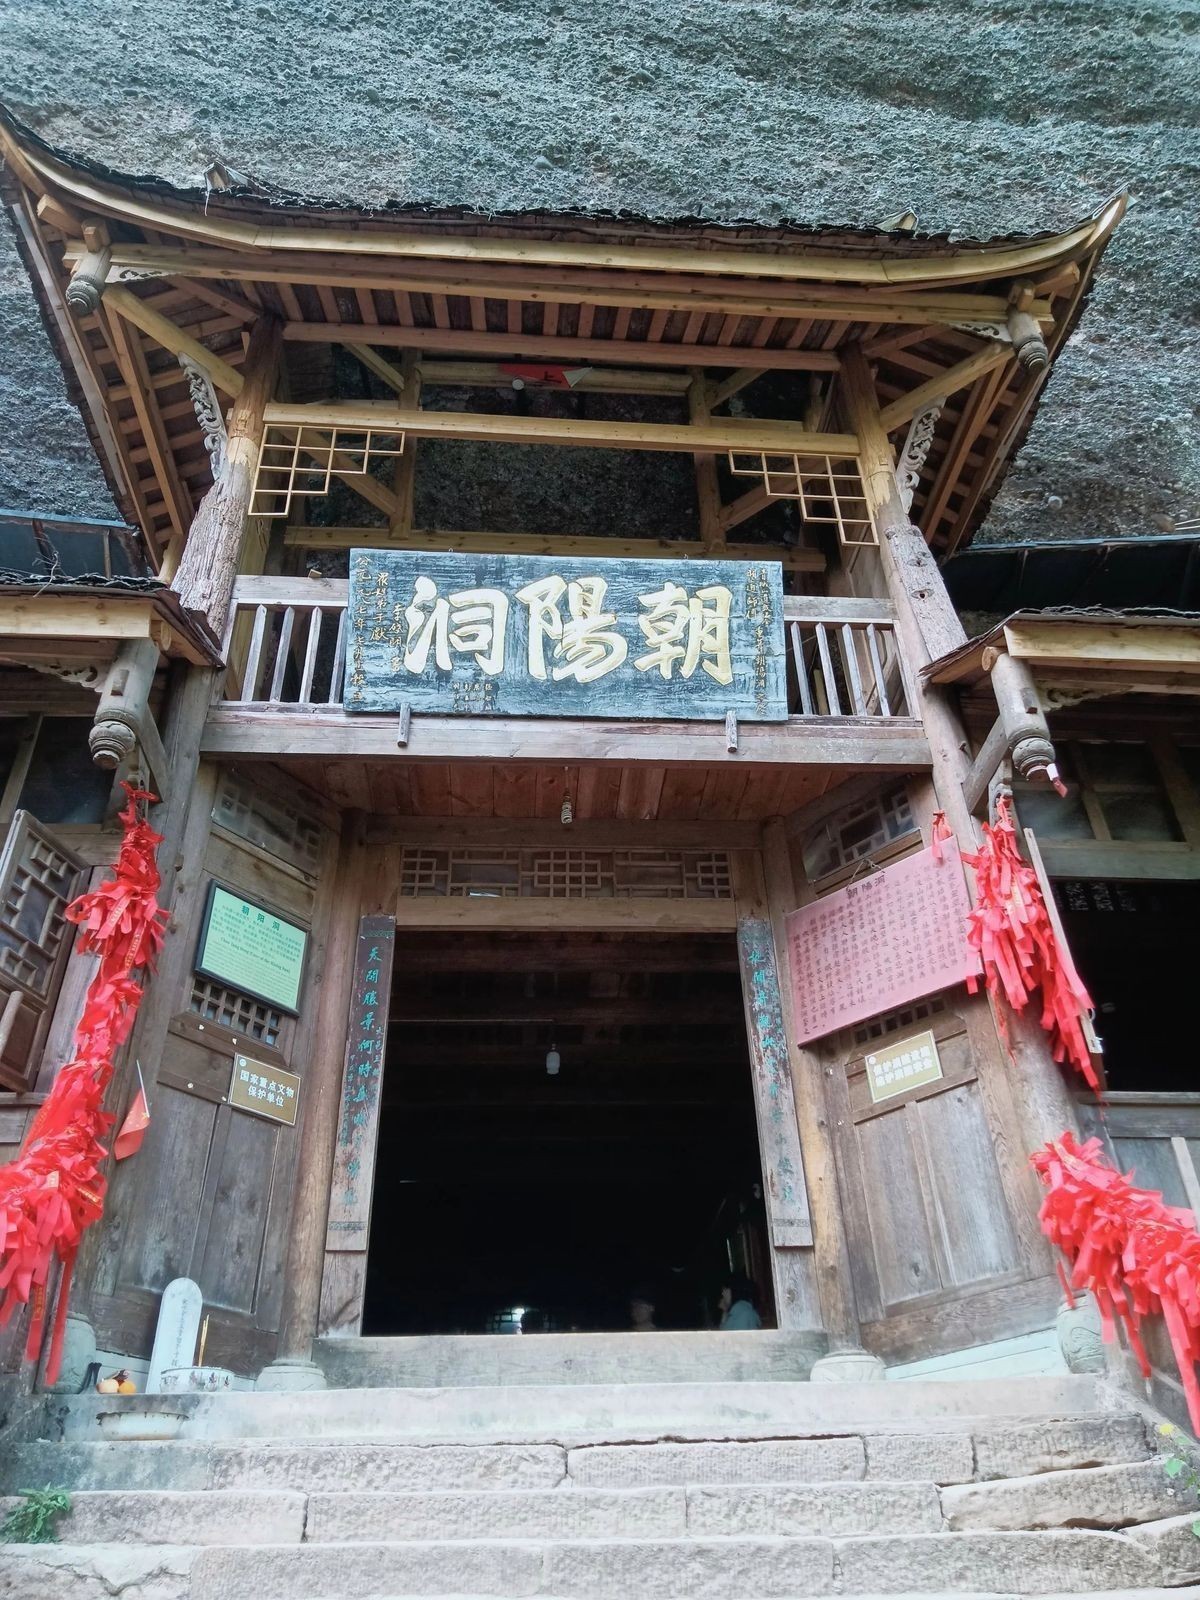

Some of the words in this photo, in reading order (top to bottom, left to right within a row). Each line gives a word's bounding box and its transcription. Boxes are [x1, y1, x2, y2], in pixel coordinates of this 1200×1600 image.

[404, 574, 735, 685] 朝陽洞
[241, 905, 281, 932] 朝阳洞
[240, 1069, 295, 1098] 国家重点文物
[247, 1085, 285, 1107] 保护单位
